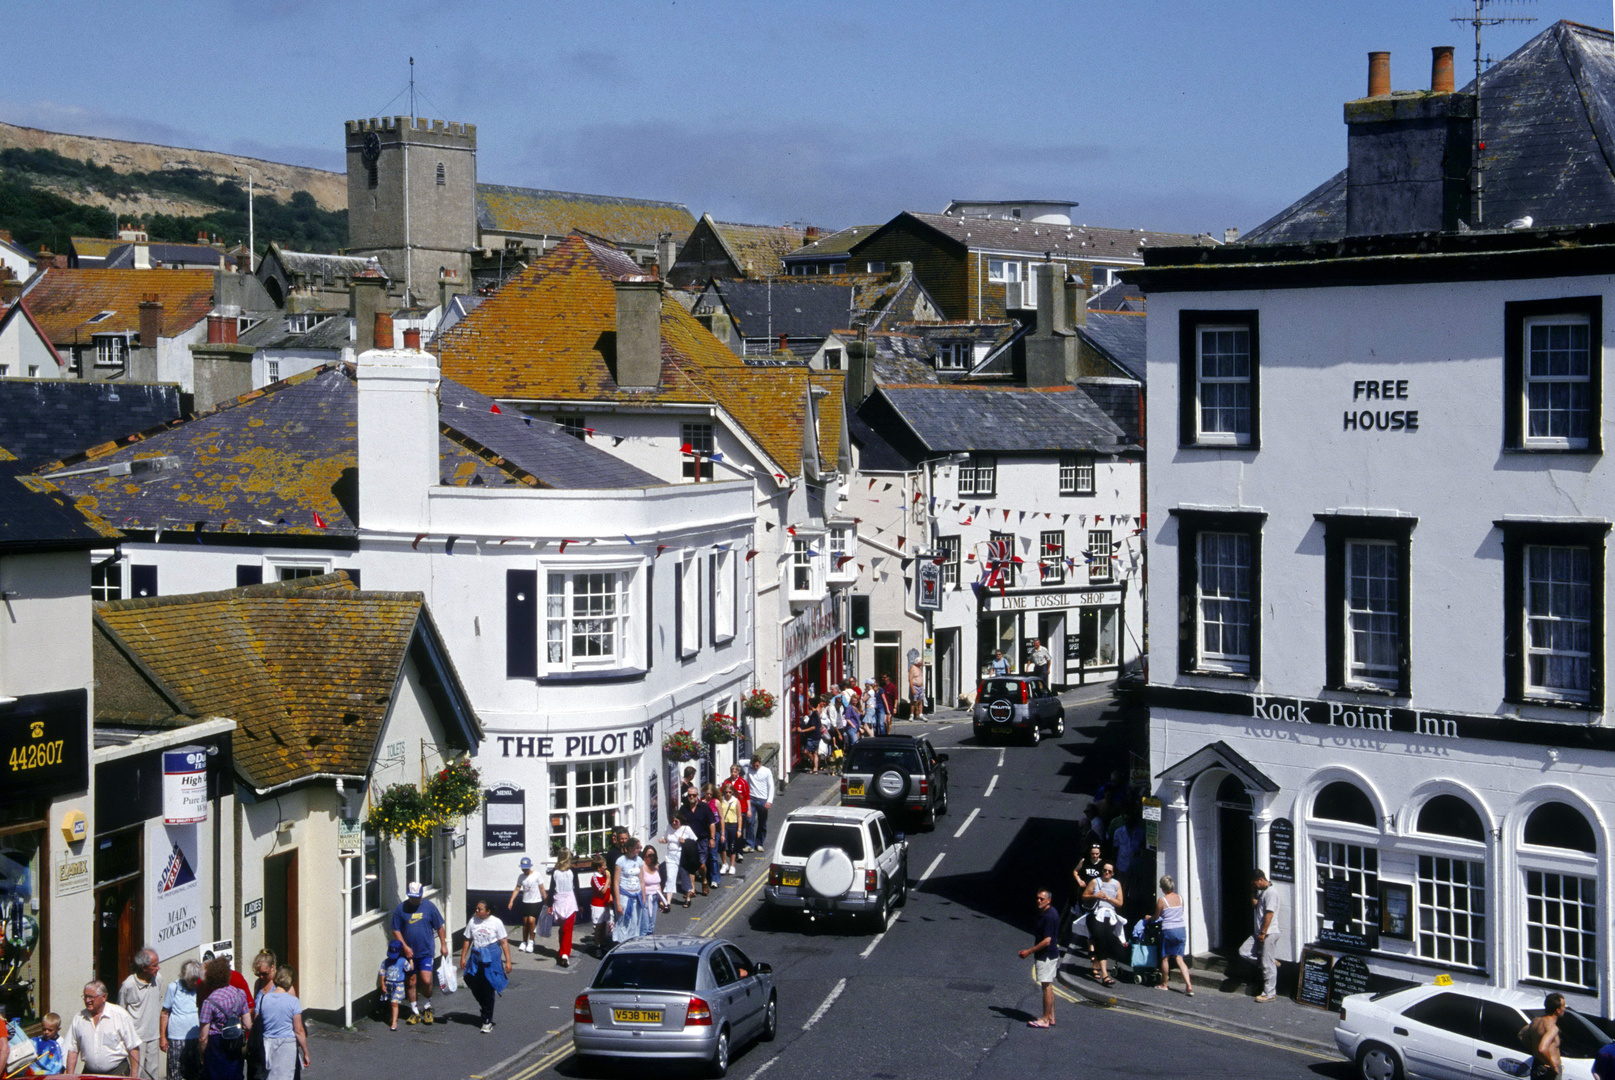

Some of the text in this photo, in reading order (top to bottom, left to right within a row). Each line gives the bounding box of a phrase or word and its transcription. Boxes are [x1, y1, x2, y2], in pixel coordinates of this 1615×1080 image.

[1353, 380, 1409, 401] FREE
[1343, 410, 1420, 431] HOUSE
[1002, 597, 1026, 609] LYME
[1034, 594, 1070, 607] FOSSIL
[1080, 592, 1104, 604] SHOP
[1252, 697, 1460, 739] Rock Point Inn
[387, 741, 405, 757] TOILETS
[497, 736, 553, 757] THE
[565, 732, 627, 757] PILOT
[9, 740, 64, 771] 442607
[182, 775, 202, 786] High
[183, 796, 200, 805] Pure
[168, 906, 187, 924] MAIN
[245, 899, 262, 915] LADIES
[158, 916, 196, 942] STOCKISTS
[616, 1011, 660, 1020] V538 TNH
